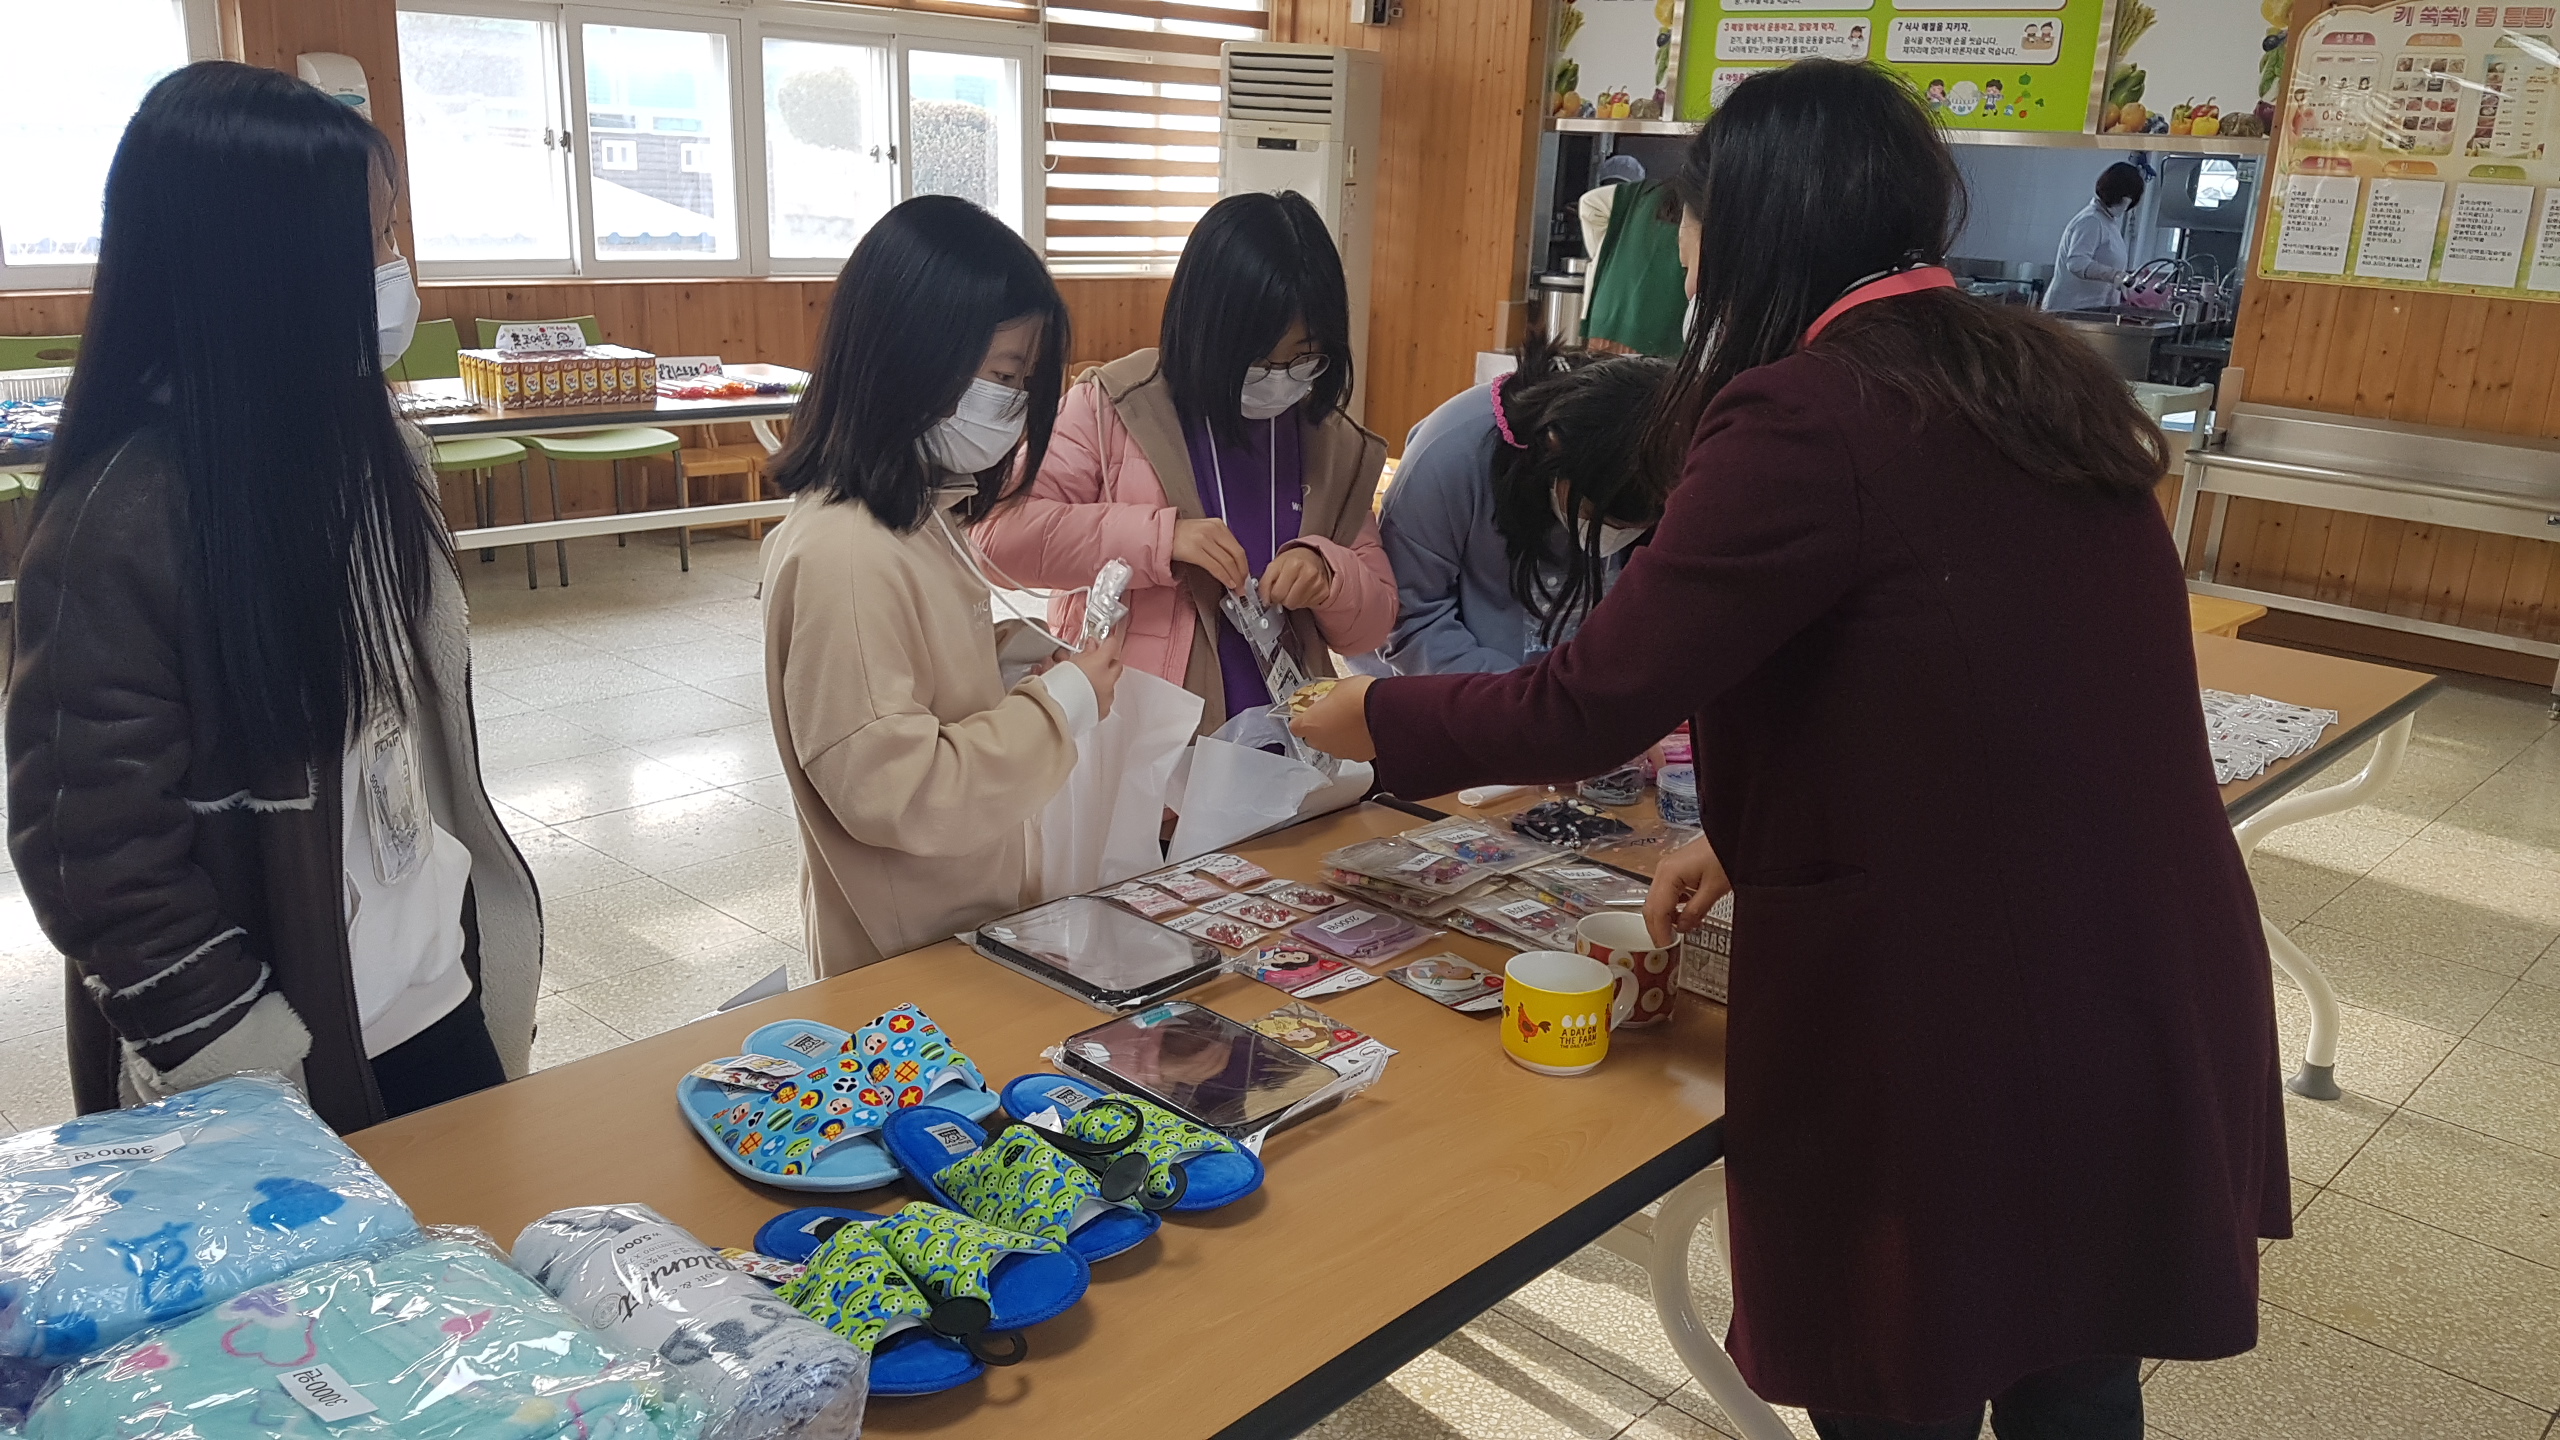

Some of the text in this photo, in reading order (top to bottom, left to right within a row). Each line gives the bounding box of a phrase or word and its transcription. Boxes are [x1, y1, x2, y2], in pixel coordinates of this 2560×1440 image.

[2393, 6, 2556, 28] 키 쑥쑥! 몸 튼튼!
[1724, 23, 1836, 31] 3 매일 밖에서 운동하고, 알맞게 먹자.
[1898, 22, 1971, 32] 7 식사 예절을 지키자.
[1730, 36, 1846, 45] 걷기, 줄넘기, 뛰어놀기 등의 운동을 합니다.
[1904, 36, 1998, 45] 음식을 먹기전에 손을 씻습니다.
[1931, 47, 1950, 55] 앉아서
[1952, 47, 1986, 55] 바른자세로
[1988, 47, 2018, 56] 먹습니다.
[1203, 897, 1239, 911] 1000원
[1324, 915, 1360, 931] 2000원
[1571, 1028, 1585, 1036] DAY
[1588, 1026, 1597, 1034] ON
[1579, 1034, 1597, 1043] FARM
[944, 1133, 967, 1145] TOY
[73, 1145, 155, 1162] 3000원
[695, 1271, 719, 1282] soft
[292, 1368, 348, 1407] 3000원
